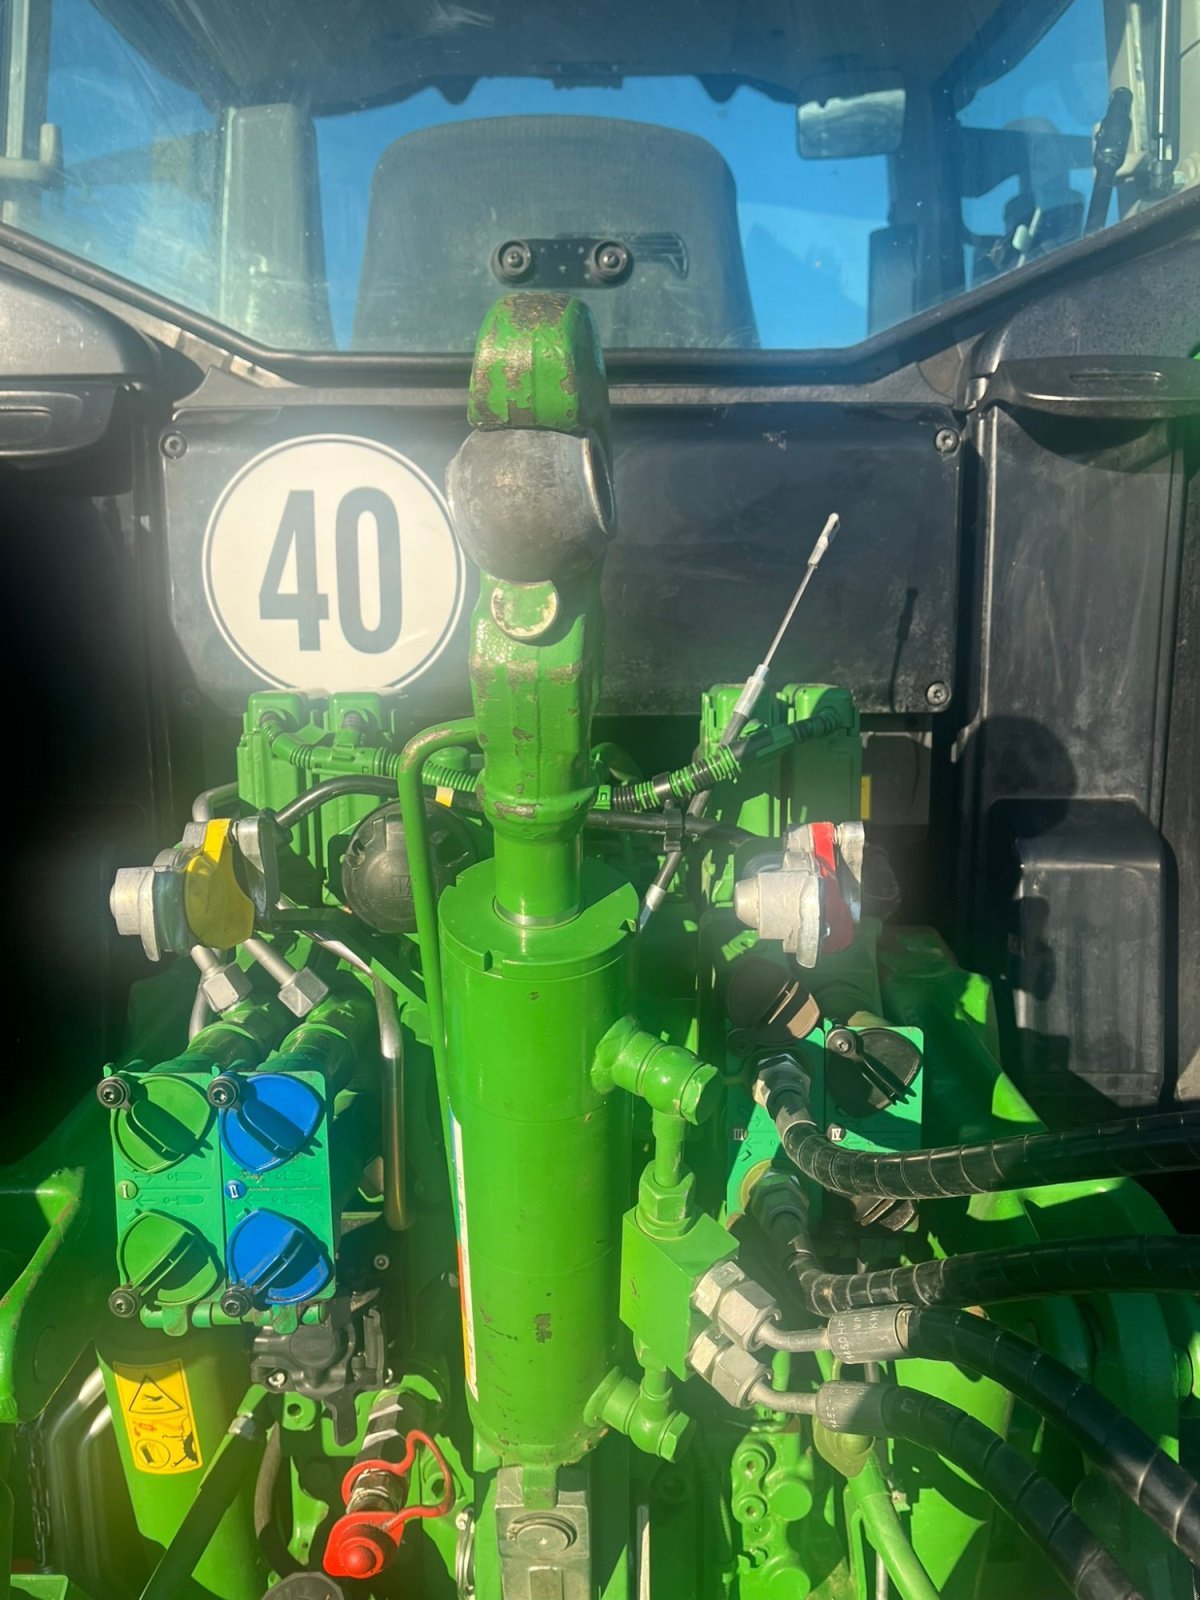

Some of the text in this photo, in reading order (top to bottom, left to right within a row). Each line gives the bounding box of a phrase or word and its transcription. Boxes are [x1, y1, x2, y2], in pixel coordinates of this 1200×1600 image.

[259, 486, 403, 655] 40
[831, 1128, 843, 1141] IV
[229, 1184, 239, 1199] II
